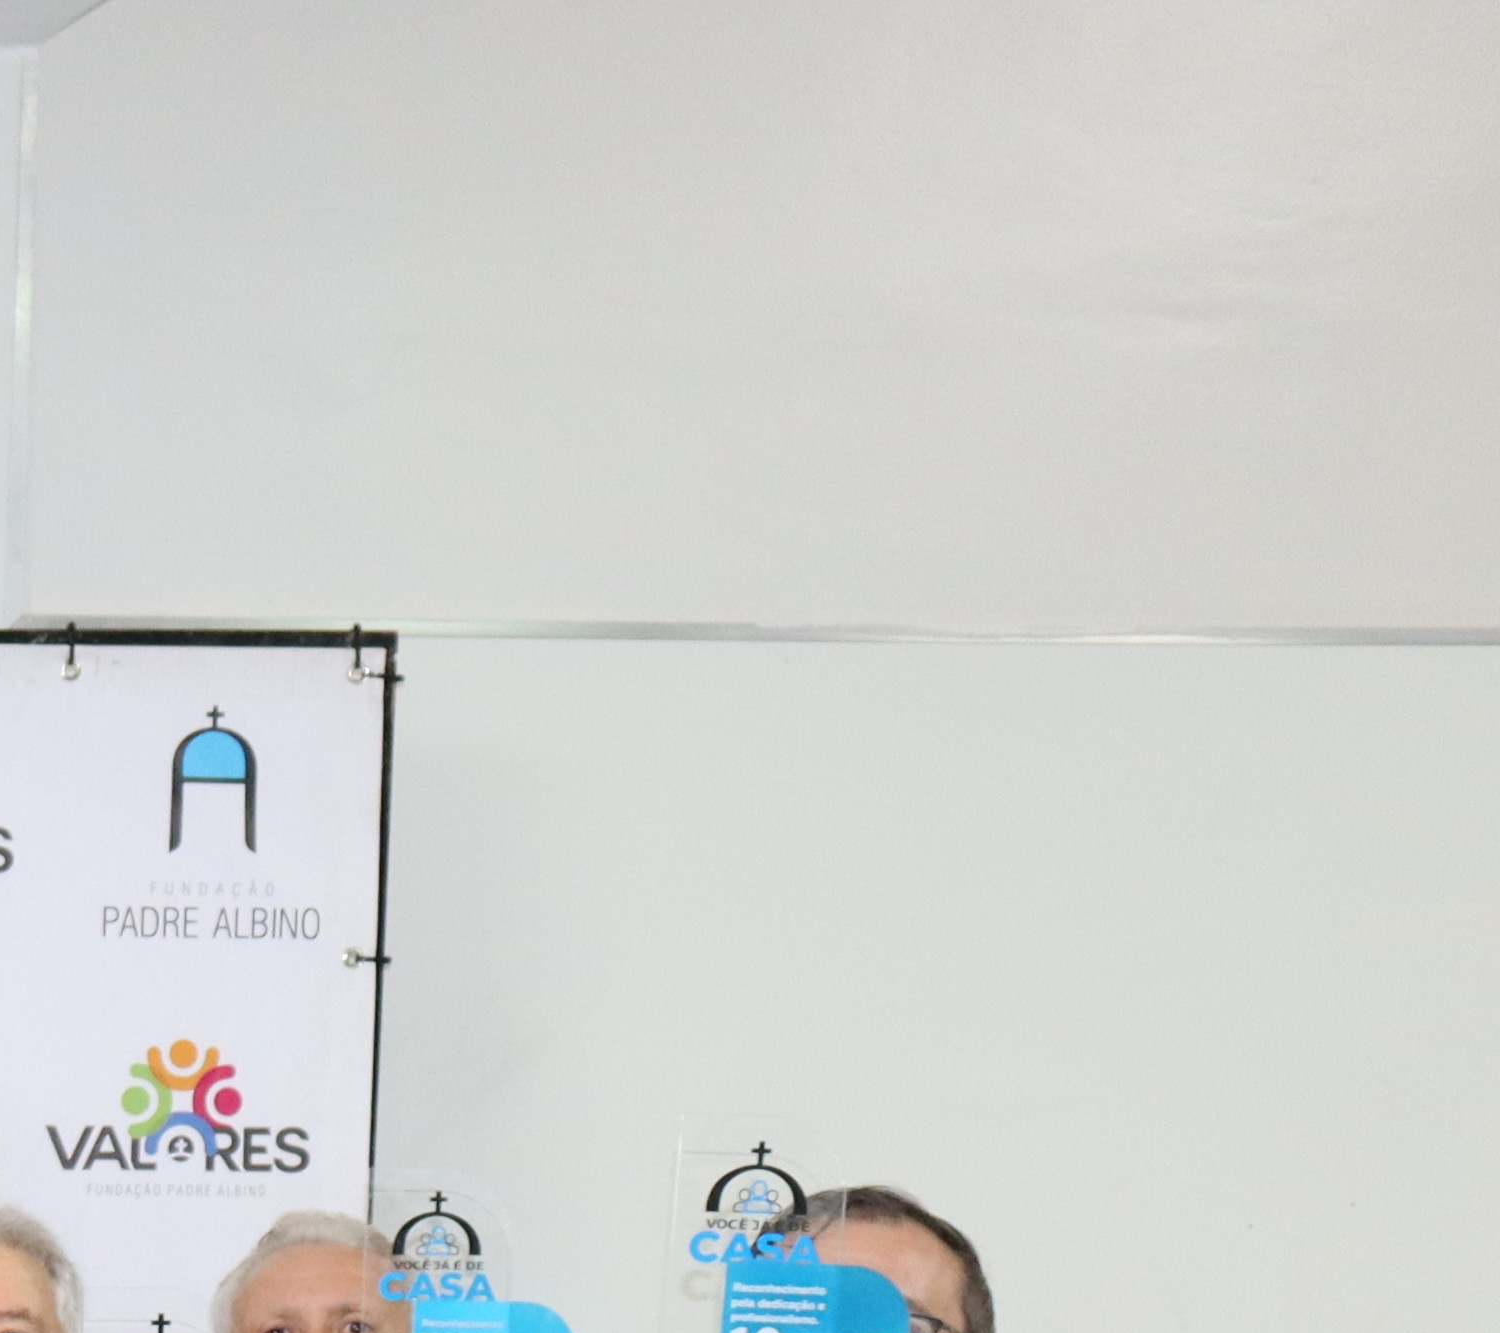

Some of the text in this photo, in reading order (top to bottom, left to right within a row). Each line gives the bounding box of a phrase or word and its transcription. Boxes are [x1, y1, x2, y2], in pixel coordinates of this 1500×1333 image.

[102, 906, 320, 940] PADRE ALBINO
[689, 1230, 821, 1264] CASA
[378, 1271, 496, 1302] CASA
